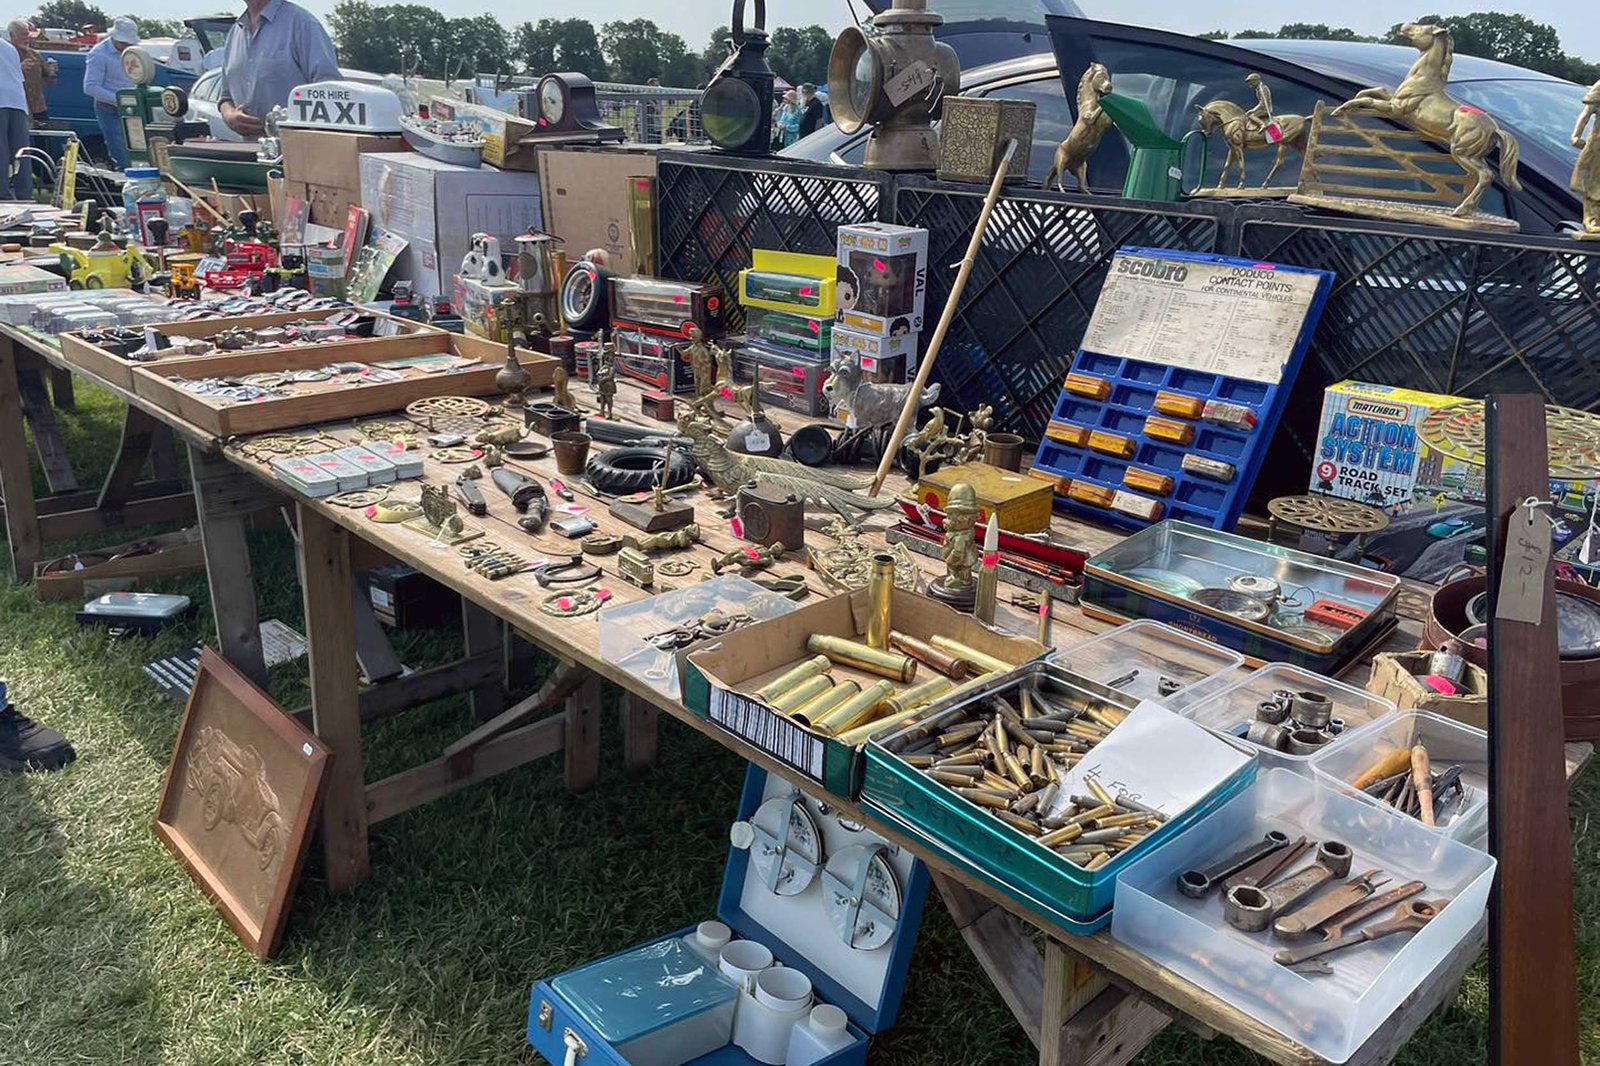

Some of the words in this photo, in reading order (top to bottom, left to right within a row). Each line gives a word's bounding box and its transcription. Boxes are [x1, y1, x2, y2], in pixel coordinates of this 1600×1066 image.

[307, 89, 326, 99] FOR
[328, 90, 351, 100] HIRE
[293, 99, 366, 126] TAXI
[914, 267, 925, 297] VAL
[1231, 267, 1275, 281] DODUCO
[1208, 274, 1254, 289] CONTACT
[1255, 280, 1293, 293] POINTS
[1201, 285, 1212, 294] FOR
[1213, 286, 1259, 299] CONTINENTAL
[1260, 292, 1294, 303] VEHICLES
[1352, 401, 1401, 417] MATCHBOX
[1331, 412, 1416, 450] ACTION
[1320, 435, 1416, 477] SYSTEM
[1320, 464, 1333, 477] 9
[1340, 466, 1378, 482] ROAD
[1338, 476, 1379, 493] TRACK
[1384, 485, 1408, 499] SET
